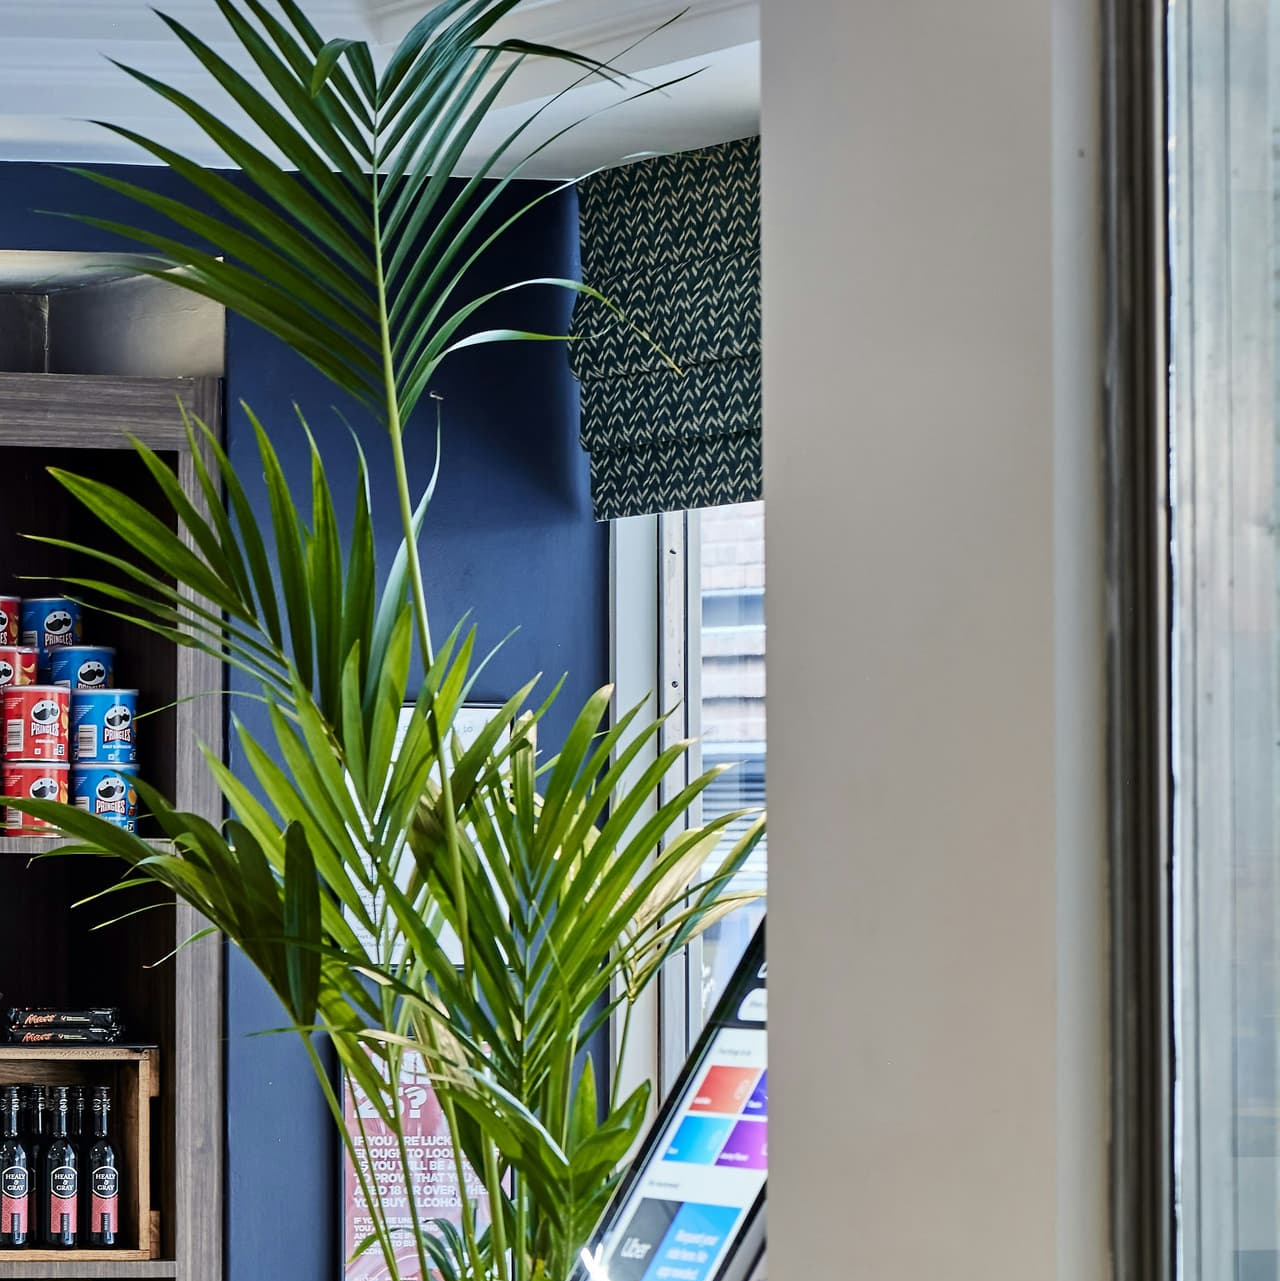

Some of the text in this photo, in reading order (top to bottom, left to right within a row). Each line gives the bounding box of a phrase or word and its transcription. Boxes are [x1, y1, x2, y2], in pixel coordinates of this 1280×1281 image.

[44, 632, 73, 646] PRINGLES
[31, 722, 59, 736] PRINGLES
[104, 728, 130, 742] PRINGLES
[96, 800, 126, 814] PRINGLES
[367, 1136, 392, 1146] YOU
[421, 1136, 453, 1146] LUCK
[407, 1149, 424, 1158] TO
[426, 1149, 453, 1158] LOO
[373, 1161, 395, 1171] YOU
[429, 1161, 445, 1171] BE
[416, 1173, 445, 1183] THAT
[389, 1186, 400, 1195] 18
[382, 1198, 406, 1207] BUY
[414, 1198, 463, 1207] LCOHOL
